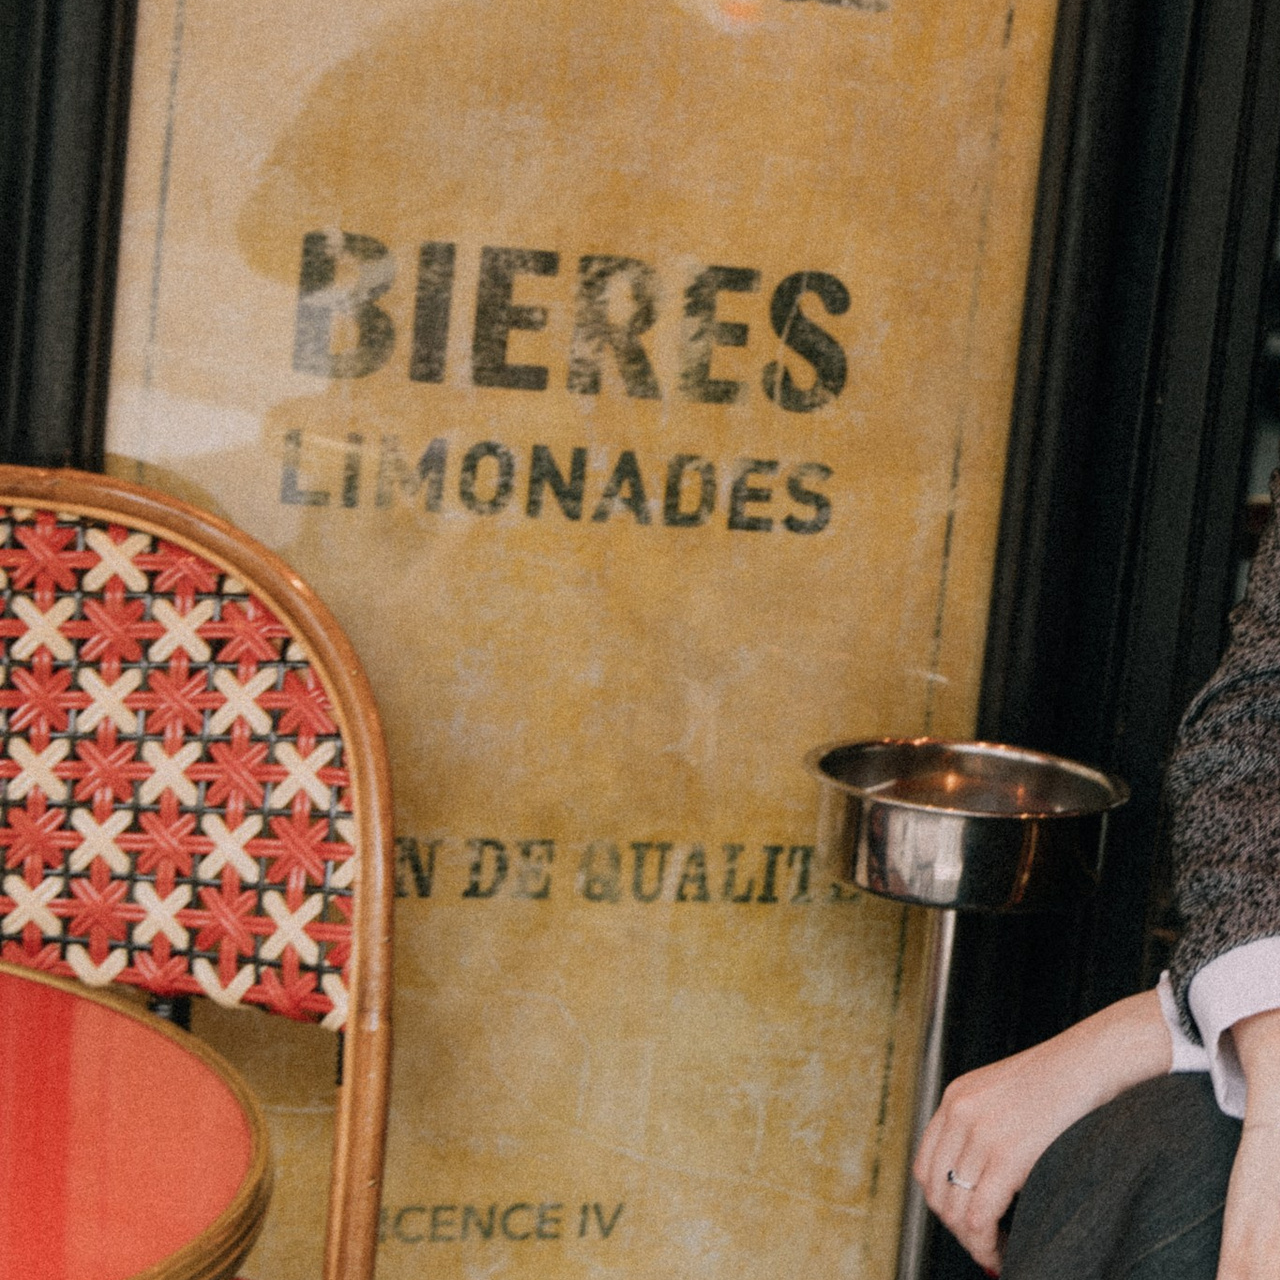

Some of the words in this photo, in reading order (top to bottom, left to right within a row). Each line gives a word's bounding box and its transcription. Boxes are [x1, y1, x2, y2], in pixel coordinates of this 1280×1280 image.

[291, 230, 852, 415] BIERES
[279, 427, 834, 537] LIMONADES
[461, 837, 555, 900] DE
[377, 1201, 564, 1245] ICENCE
[577, 1201, 627, 1239] IV
